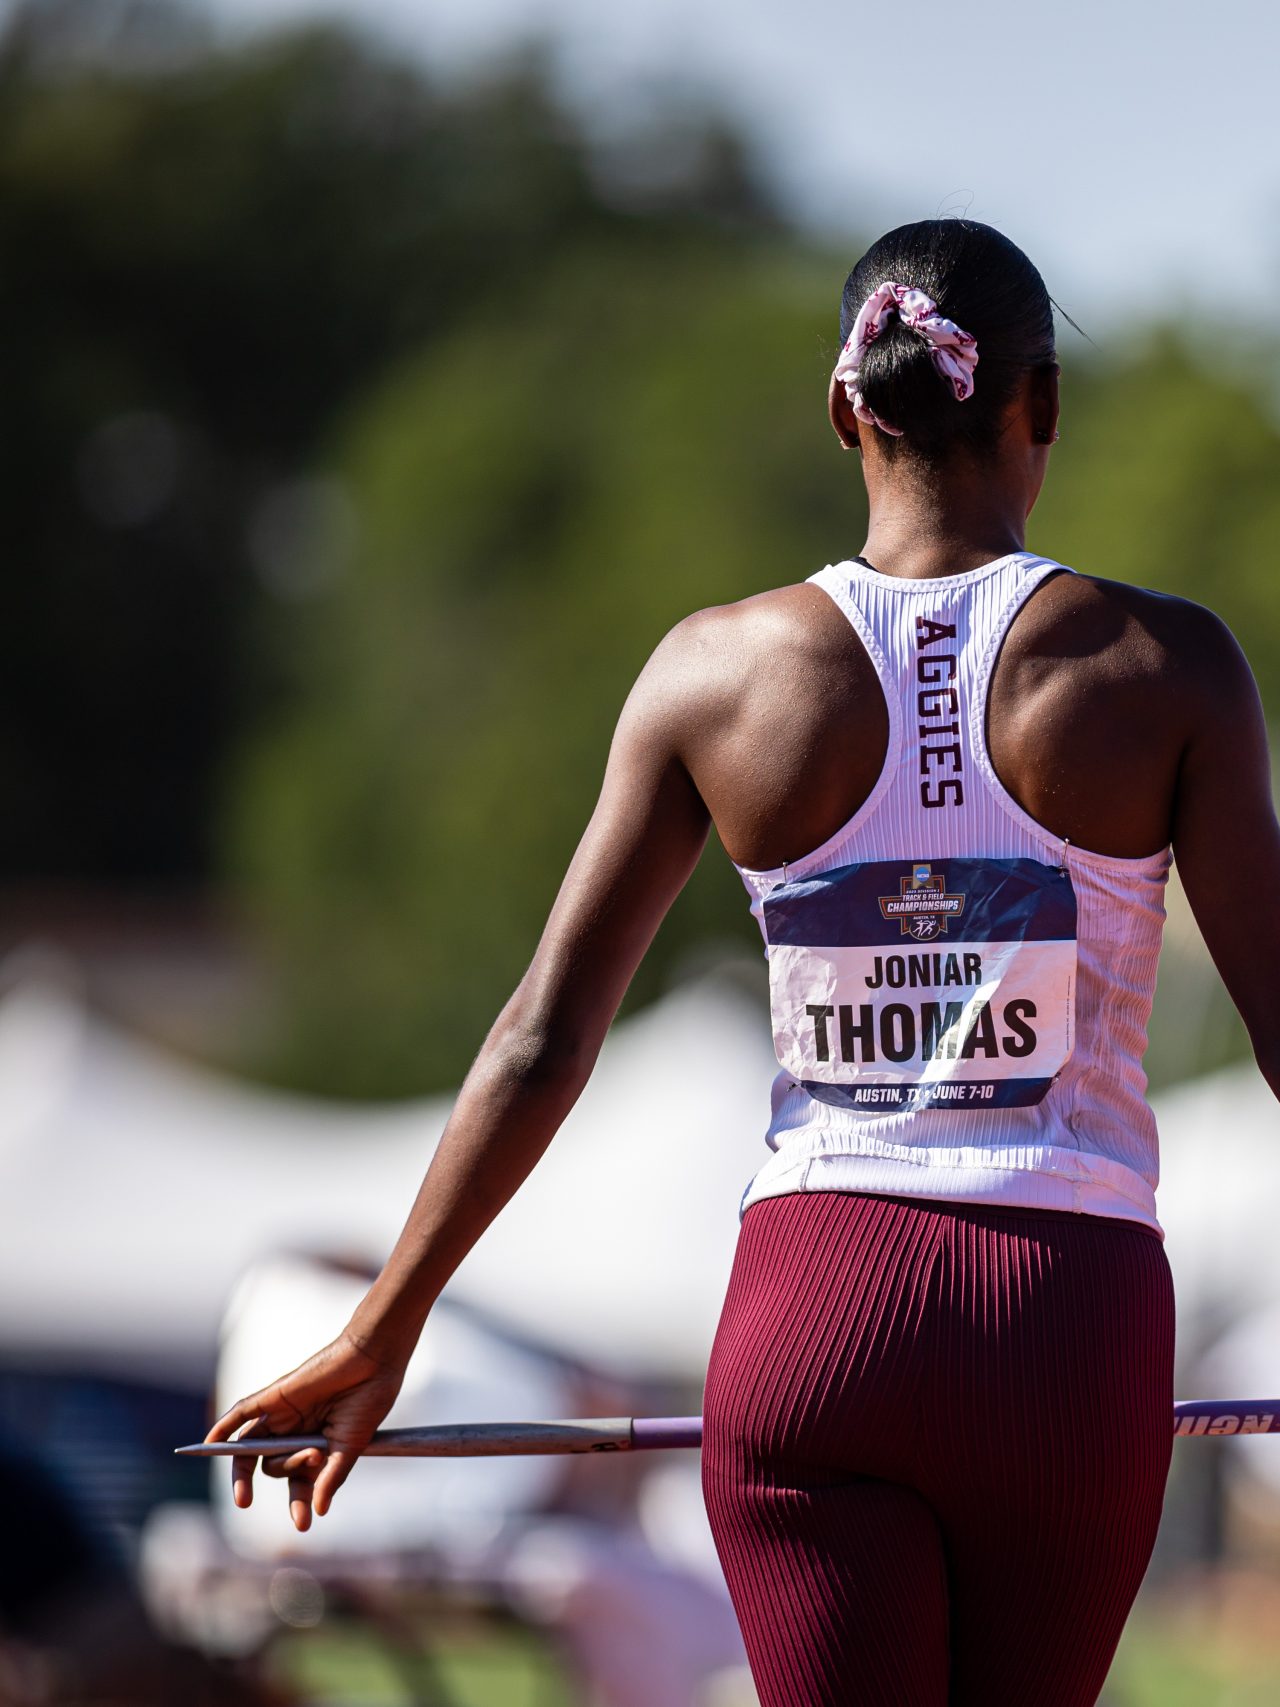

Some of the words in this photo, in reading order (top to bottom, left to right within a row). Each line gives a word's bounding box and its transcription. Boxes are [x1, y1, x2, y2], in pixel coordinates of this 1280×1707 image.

[916, 616, 964, 808] AGGIES
[887, 901, 959, 913] CHAMPIONSHIPS
[922, 893, 927, 901] &
[864, 953, 982, 989] JONIAR
[805, 999, 1038, 1062] THOMAS
[854, 1088, 903, 1104] AUSTIN,
[906, 1088, 921, 1102] TX
[932, 1085, 967, 1100] JUNE
[969, 1084, 994, 1099] 7-10
